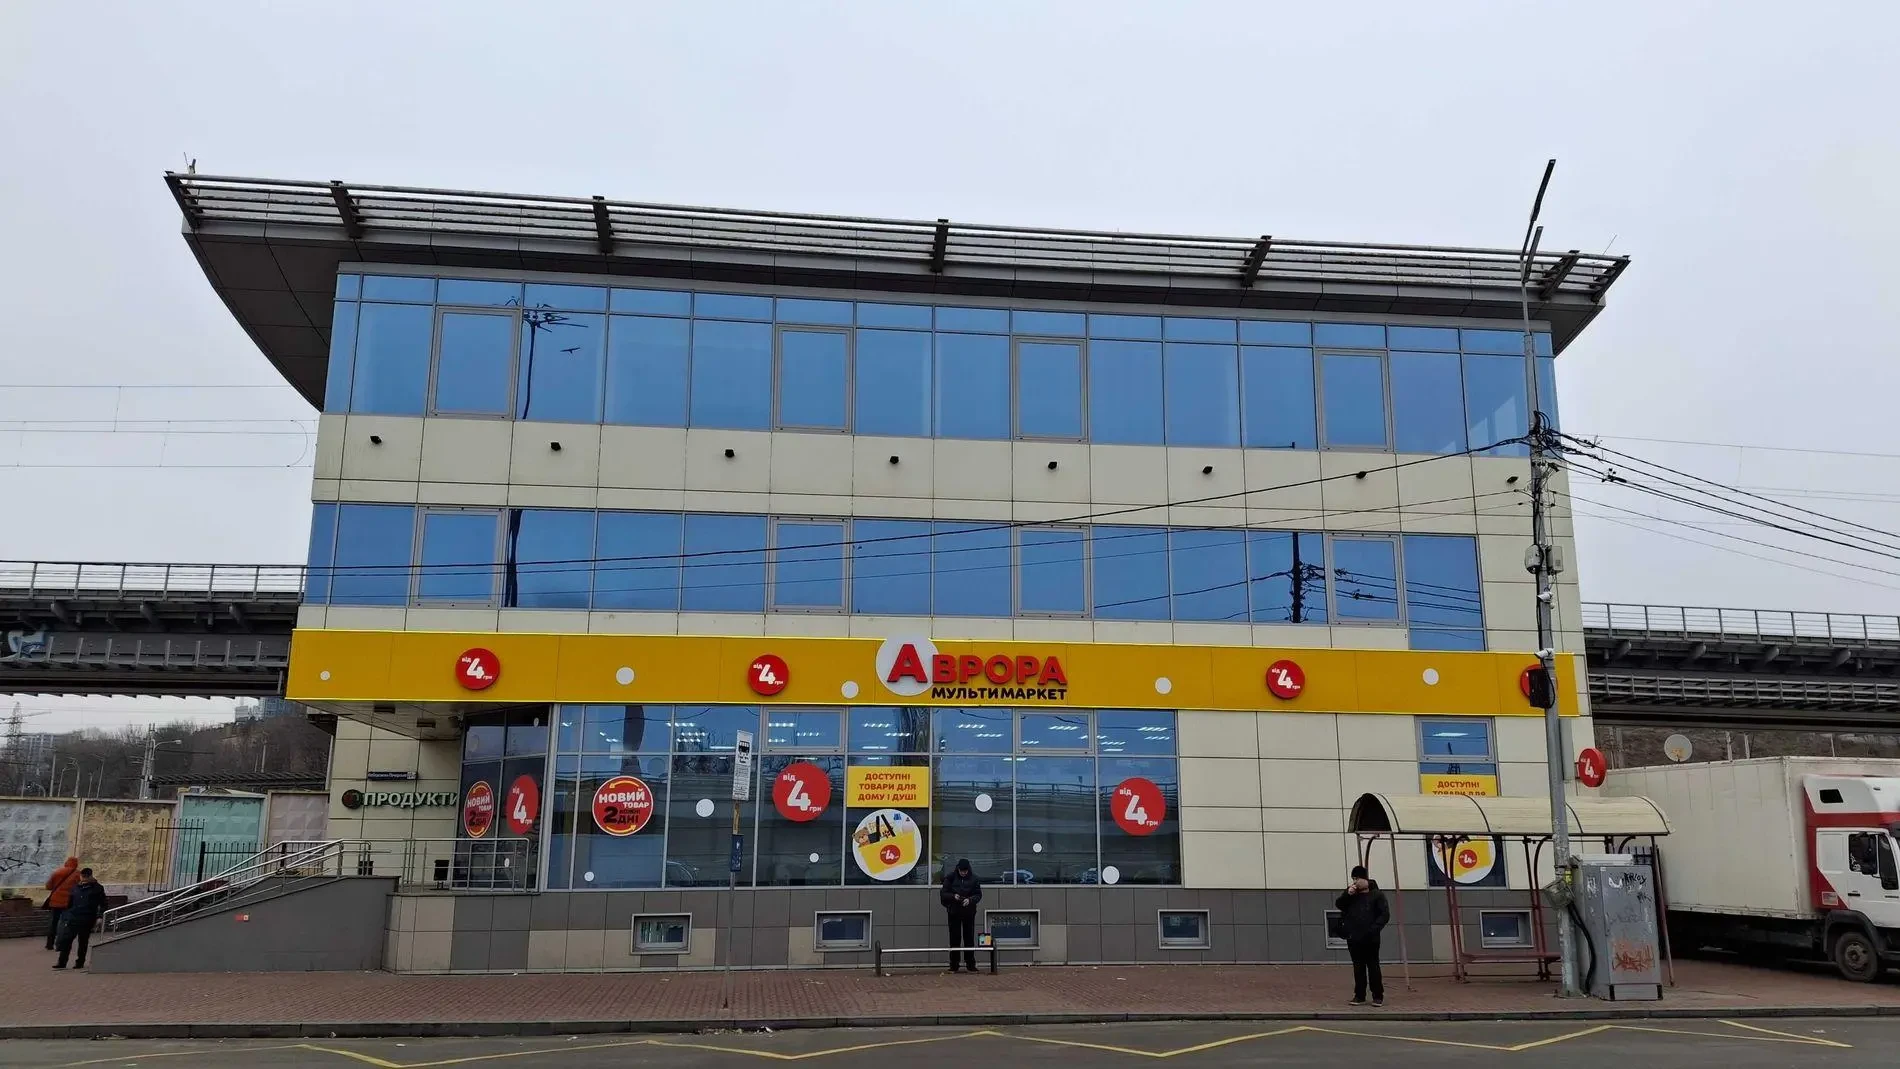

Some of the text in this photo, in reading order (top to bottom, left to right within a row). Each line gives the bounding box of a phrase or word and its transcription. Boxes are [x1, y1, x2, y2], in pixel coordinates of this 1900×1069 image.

[467, 658, 485, 680] 4
[887, 643, 1067, 685] АВРОРА
[759, 664, 776, 685] 4
[1277, 669, 1293, 689] 4
[931, 687, 1067, 700] МУЛЬТИМАРКЕТ
[1585, 757, 1595, 778] 4
[782, 773, 796, 782] від
[864, 773, 911, 781] ДОСТУПНІ
[787, 780, 811, 811] 4
[859, 783, 917, 792] ТОВАРИ ДЛЯ
[1119, 787, 1132, 796] від
[467, 792, 491, 808] НОВИЙ
[598, 788, 645, 804] НОВИЙ
[858, 793, 886, 802] ДОМУ
[892, 793, 917, 802] ДУШІ
[513, 793, 527, 824] 4
[622, 801, 650, 809] ТОВАР
[1125, 795, 1148, 825] 4
[603, 806, 639, 825] 2 ДНІ
[1146, 820, 1158, 828] грн
